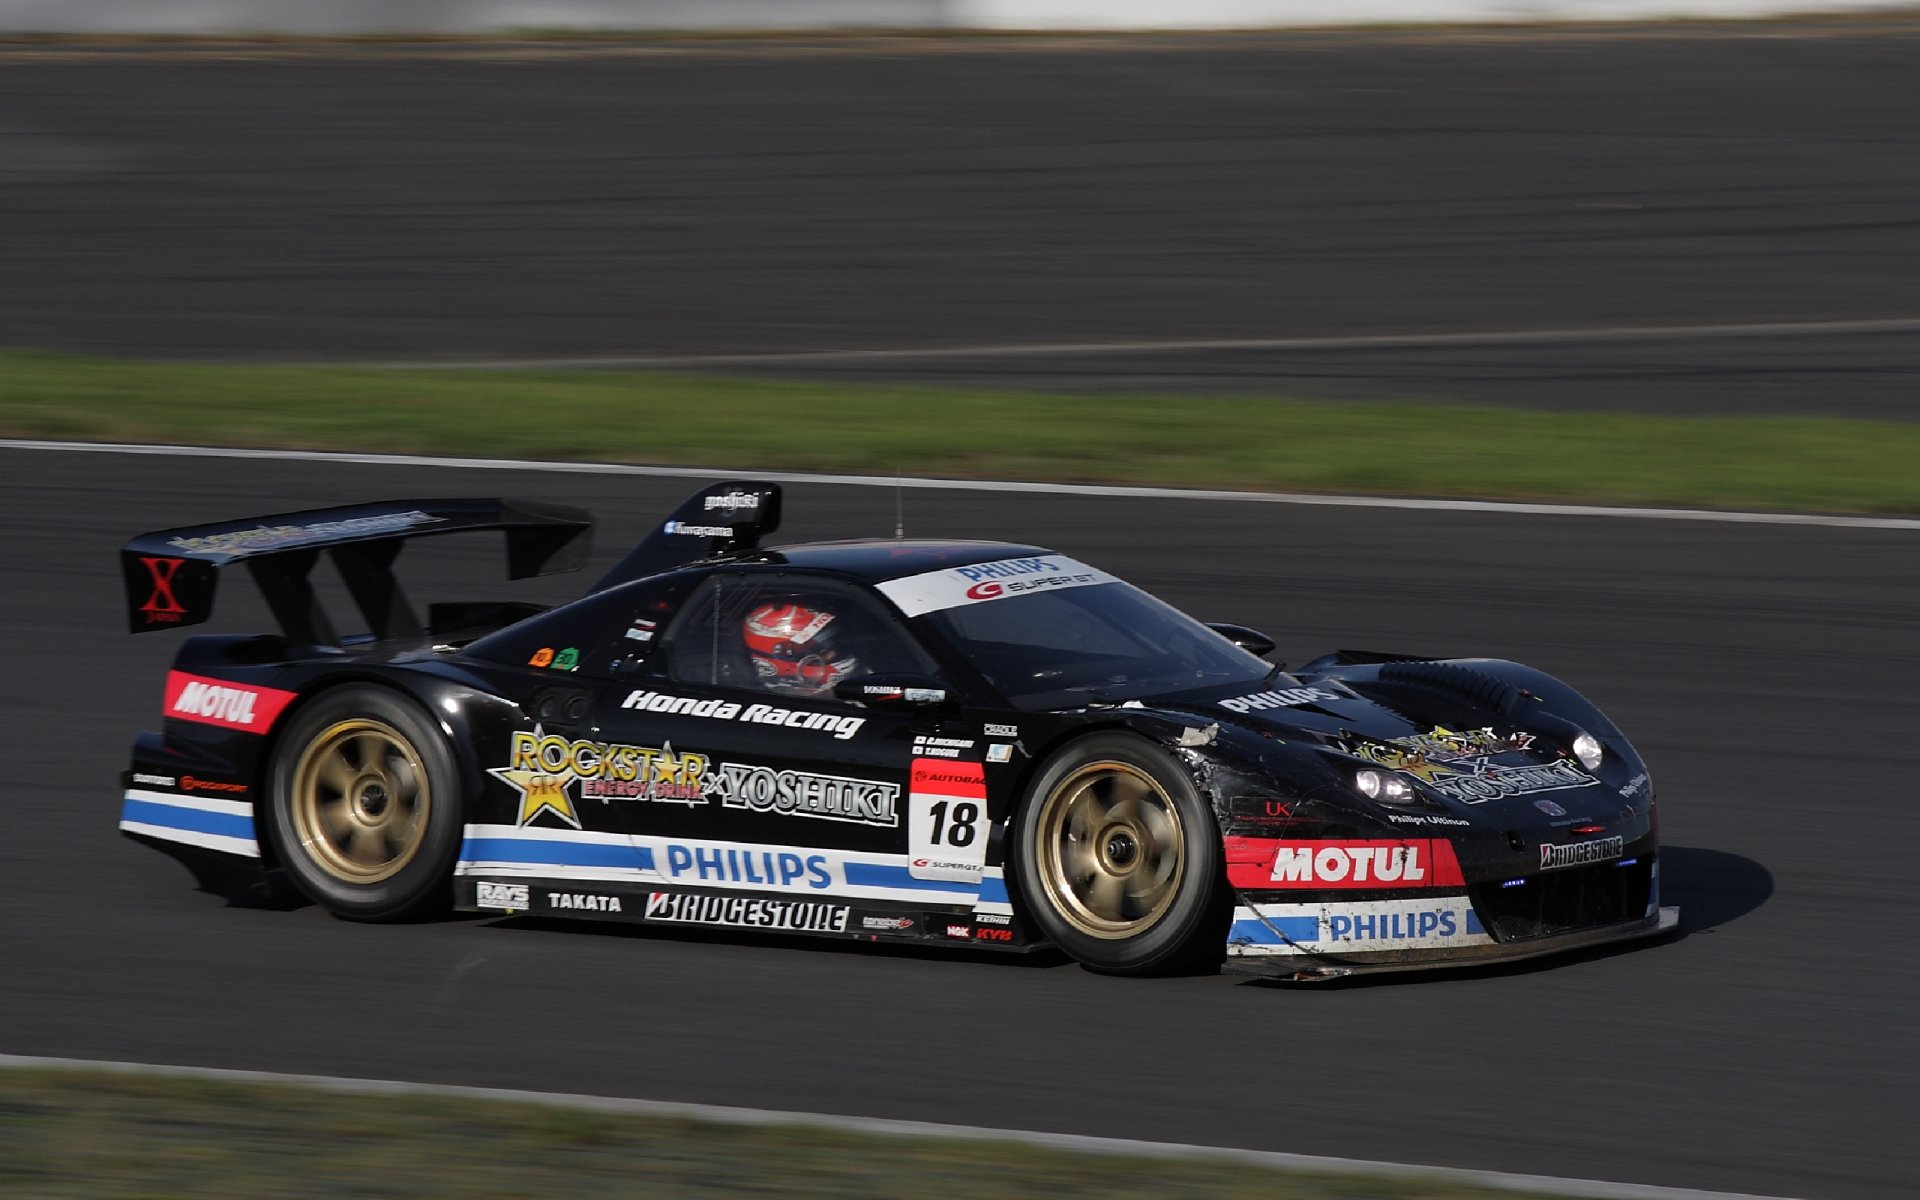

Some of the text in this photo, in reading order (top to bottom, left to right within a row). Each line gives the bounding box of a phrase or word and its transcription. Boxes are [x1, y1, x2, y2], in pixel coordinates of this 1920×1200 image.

[138, 557, 189, 612] X
[956, 557, 1061, 582] PHILIPS
[173, 681, 259, 724] MOTUL
[621, 689, 867, 740] Honda Racing
[1217, 687, 1339, 714] PHILIPS
[512, 732, 706, 784] ROCKSTAR
[723, 763, 900, 826] YOSHIKI
[584, 781, 702, 799] ENERGY DRINK
[1436, 760, 1596, 804] YOSHIKI
[929, 800, 978, 847] 18
[1265, 801, 1292, 816] UK
[1388, 815, 1427, 826] Philips
[667, 844, 832, 889] PHILIPS
[1270, 847, 1424, 882] MOTUL
[1540, 836, 1624, 870] BRIDGESTONE
[477, 885, 529, 901] RAYS
[548, 893, 622, 912] TAKATA
[645, 892, 850, 933] BRIDGESTONE
[976, 915, 1011, 925] KEIHIN
[1330, 911, 1456, 941] PHILIPS
[947, 926, 969, 937] NGK
[976, 928, 1012, 941] KYB
